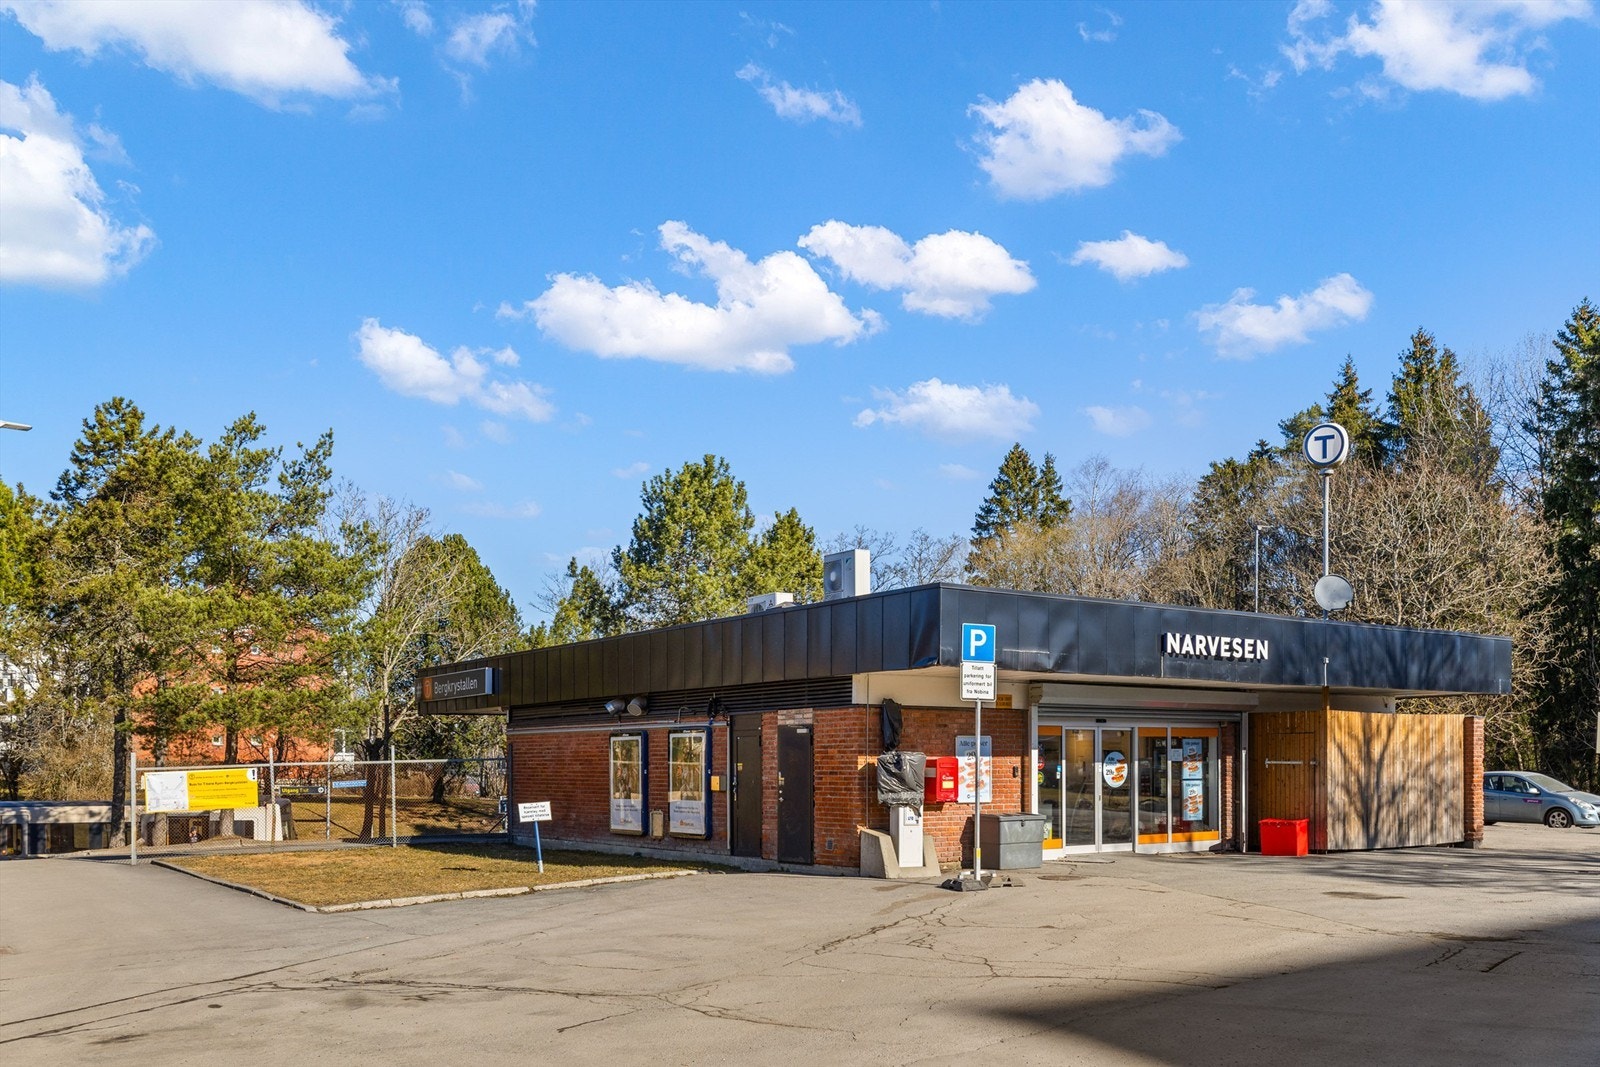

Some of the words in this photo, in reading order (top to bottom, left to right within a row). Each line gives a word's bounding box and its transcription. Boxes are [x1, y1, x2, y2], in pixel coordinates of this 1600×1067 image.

[1314, 434, 1335, 459] T
[970, 628, 987, 657] P
[1166, 632, 1269, 660] NARVESEN
[434, 677, 478, 696] Bergkrystallen
